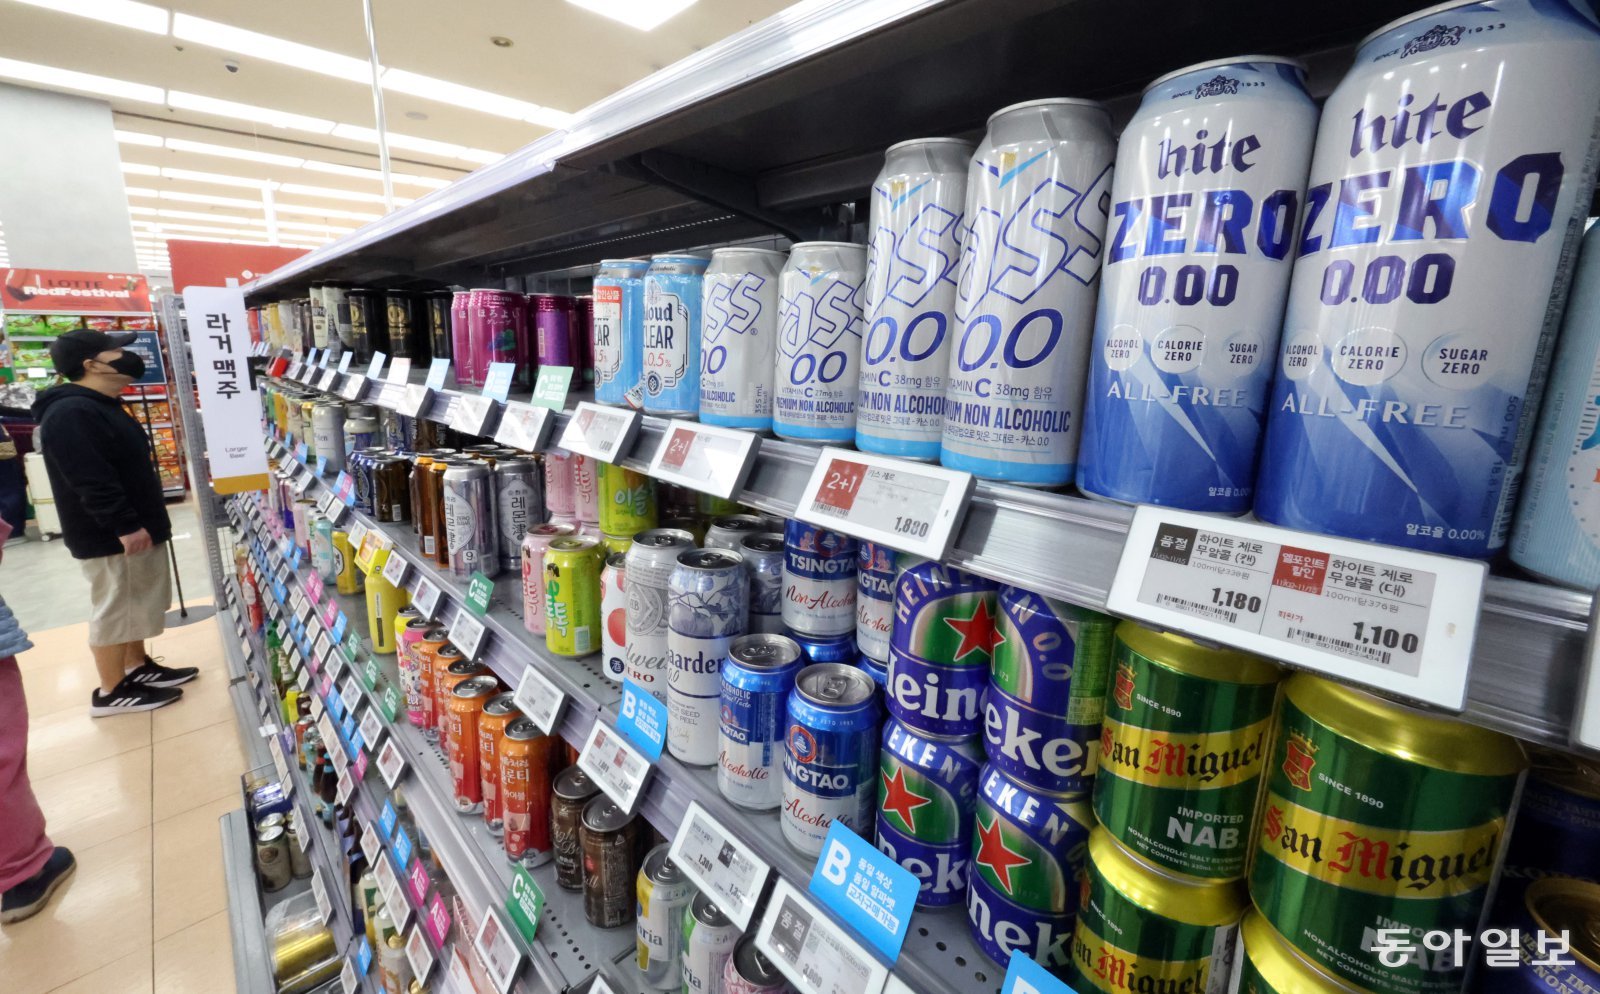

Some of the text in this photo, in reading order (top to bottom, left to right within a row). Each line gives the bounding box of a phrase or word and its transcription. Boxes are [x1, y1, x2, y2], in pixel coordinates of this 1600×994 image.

[1468, 23, 1506, 35] 1933
[1350, 91, 1492, 158] hite
[1158, 130, 1261, 180] hite
[1298, 152, 1566, 258] ZERO
[1107, 190, 1299, 266] ZERO
[47, 279, 104, 289] LOTTE
[1138, 265, 1240, 306] 0.00
[1320, 253, 1456, 306] 0.00
[23, 286, 130, 298] RedFestival
[865, 310, 947, 366] 0.0
[957, 308, 1063, 372] 0.0
[1106, 338, 1139, 350] ALCOHOL
[1157, 341, 1203, 352] CALORIE
[1228, 343, 1258, 354] SUGAR
[206, 313, 241, 400] 라거 맥주
[1110, 348, 1131, 359] ZERO
[1164, 351, 1193, 362] ZERO
[1230, 353, 1254, 365] ZERO
[1288, 355, 1308, 367] ZERO
[1340, 345, 1400, 359] CALORIE
[1439, 348, 1489, 362] SUGAR
[790, 350, 847, 385] 0.0
[1347, 357, 1384, 371] ZERO
[1441, 361, 1481, 375] ZERO
[878, 370, 892, 387] C
[894, 374, 922, 388] 38mg
[975, 378, 991, 398] C
[995, 383, 1030, 400] 38mg
[804, 388, 813, 398] C
[871, 392, 892, 412] NON
[1107, 382, 1250, 408] ALL-FREE
[799, 399, 814, 412] NON
[815, 400, 855, 414] ALCOHOLIC
[1282, 394, 1473, 429] ALL-FREE
[965, 404, 1072, 433] NON ALCOHOLIC
[670, 438, 688, 455] 2+1
[826, 472, 857, 493] 2+1
[1160, 534, 1189, 551] 품절
[1199, 534, 1264, 555] 하이트 제로
[1448, 528, 1485, 540] 0.00%
[1196, 544, 1232, 561] 무알콜
[1282, 551, 1326, 570] 엘포인트
[789, 553, 858, 575] TSINGTA
[1291, 565, 1315, 580] 할인
[1332, 559, 1414, 585] 하이트 제로
[1328, 571, 1406, 598] 무알콜 (대)
[1211, 587, 1262, 613] 1,180
[1353, 621, 1419, 654] 1,100
[622, 689, 637, 719] B
[1136, 692, 1182, 718] SINCE 1890
[1101, 726, 1264, 782] San Miguel
[1317, 772, 1385, 809] SINCE 1890
[1177, 806, 1244, 825] IMPORTED
[1127, 826, 1188, 858] NON-ALCOHOLIC
[1166, 816, 1241, 850] NAB
[1264, 804, 1499, 891] San Miguel
[821, 838, 851, 886] B
[858, 857, 876, 877] 동일
[512, 873, 524, 899] C
[853, 871, 871, 891] 동일
[781, 910, 806, 941] 품절
[1074, 935, 1093, 968] an
[1303, 928, 1389, 979] NON-ALCOHOLIC
[1316, 947, 1335, 963] NET
